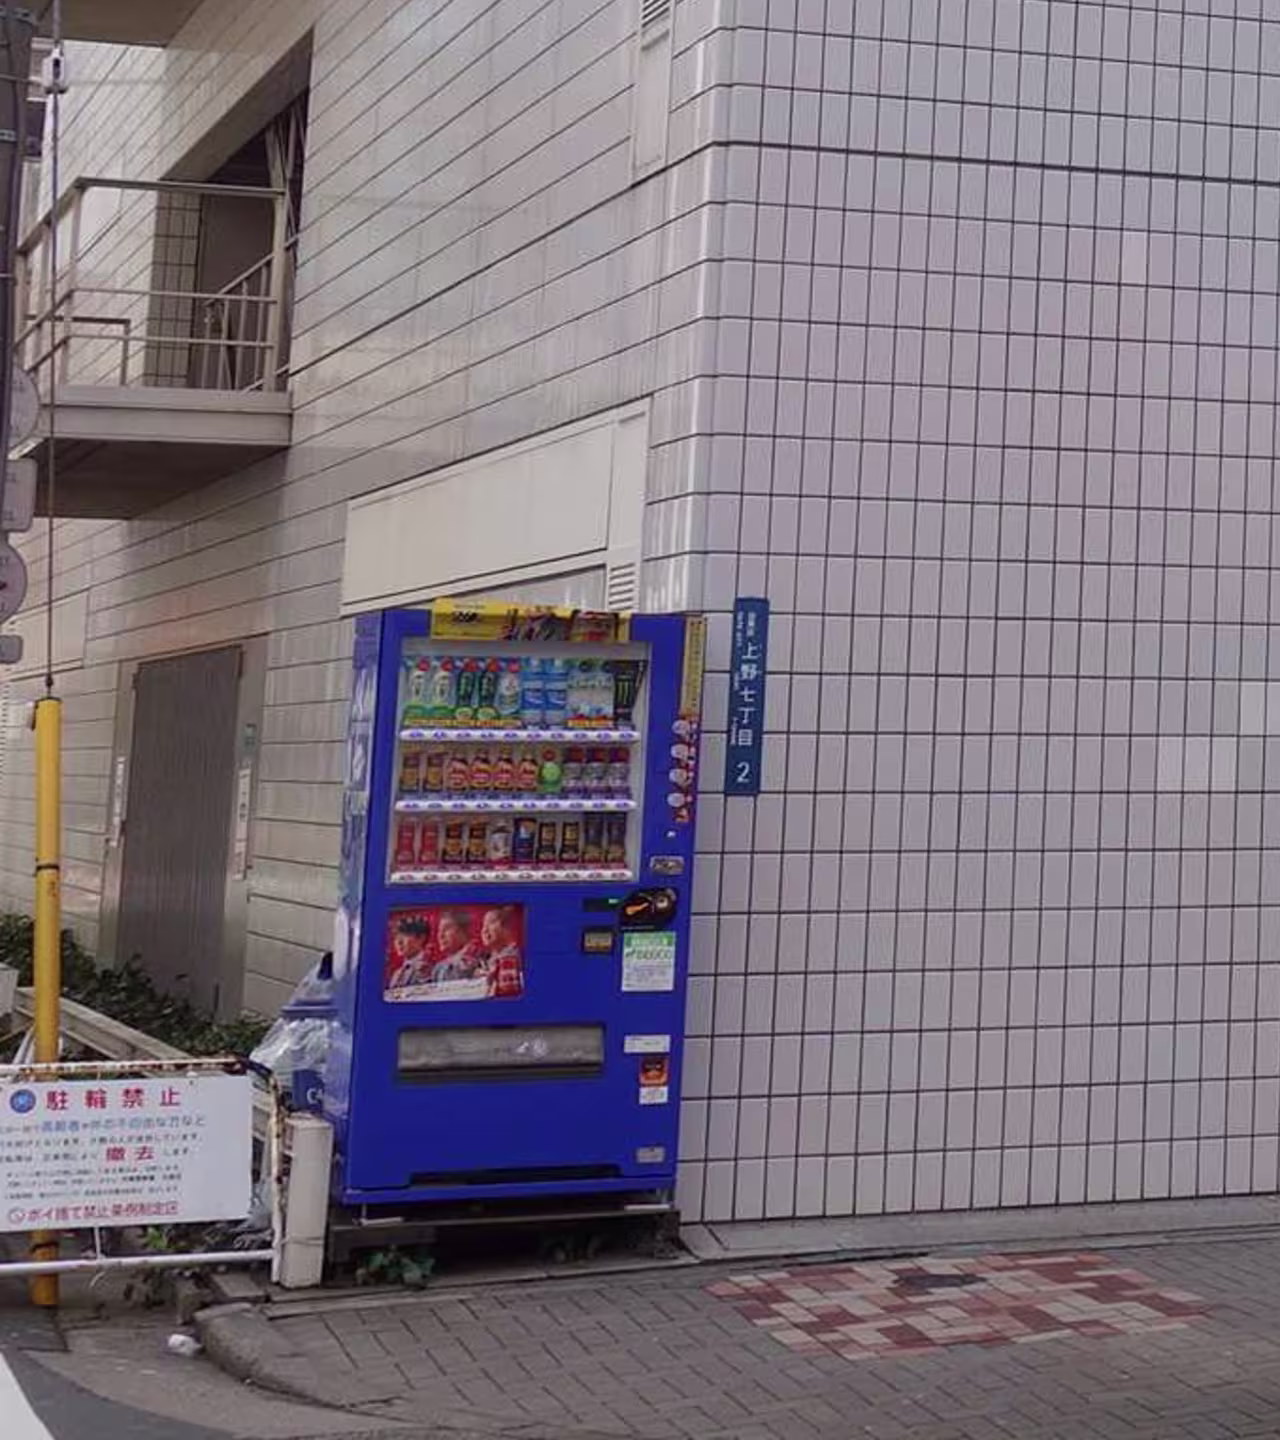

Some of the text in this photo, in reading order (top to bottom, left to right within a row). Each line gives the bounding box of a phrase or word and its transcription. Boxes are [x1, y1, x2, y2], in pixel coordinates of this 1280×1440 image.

[738, 642, 760, 746] 上野七丁目
[736, 762, 750, 783] 2
[46, 1088, 181, 1111] 駐輪禁止
